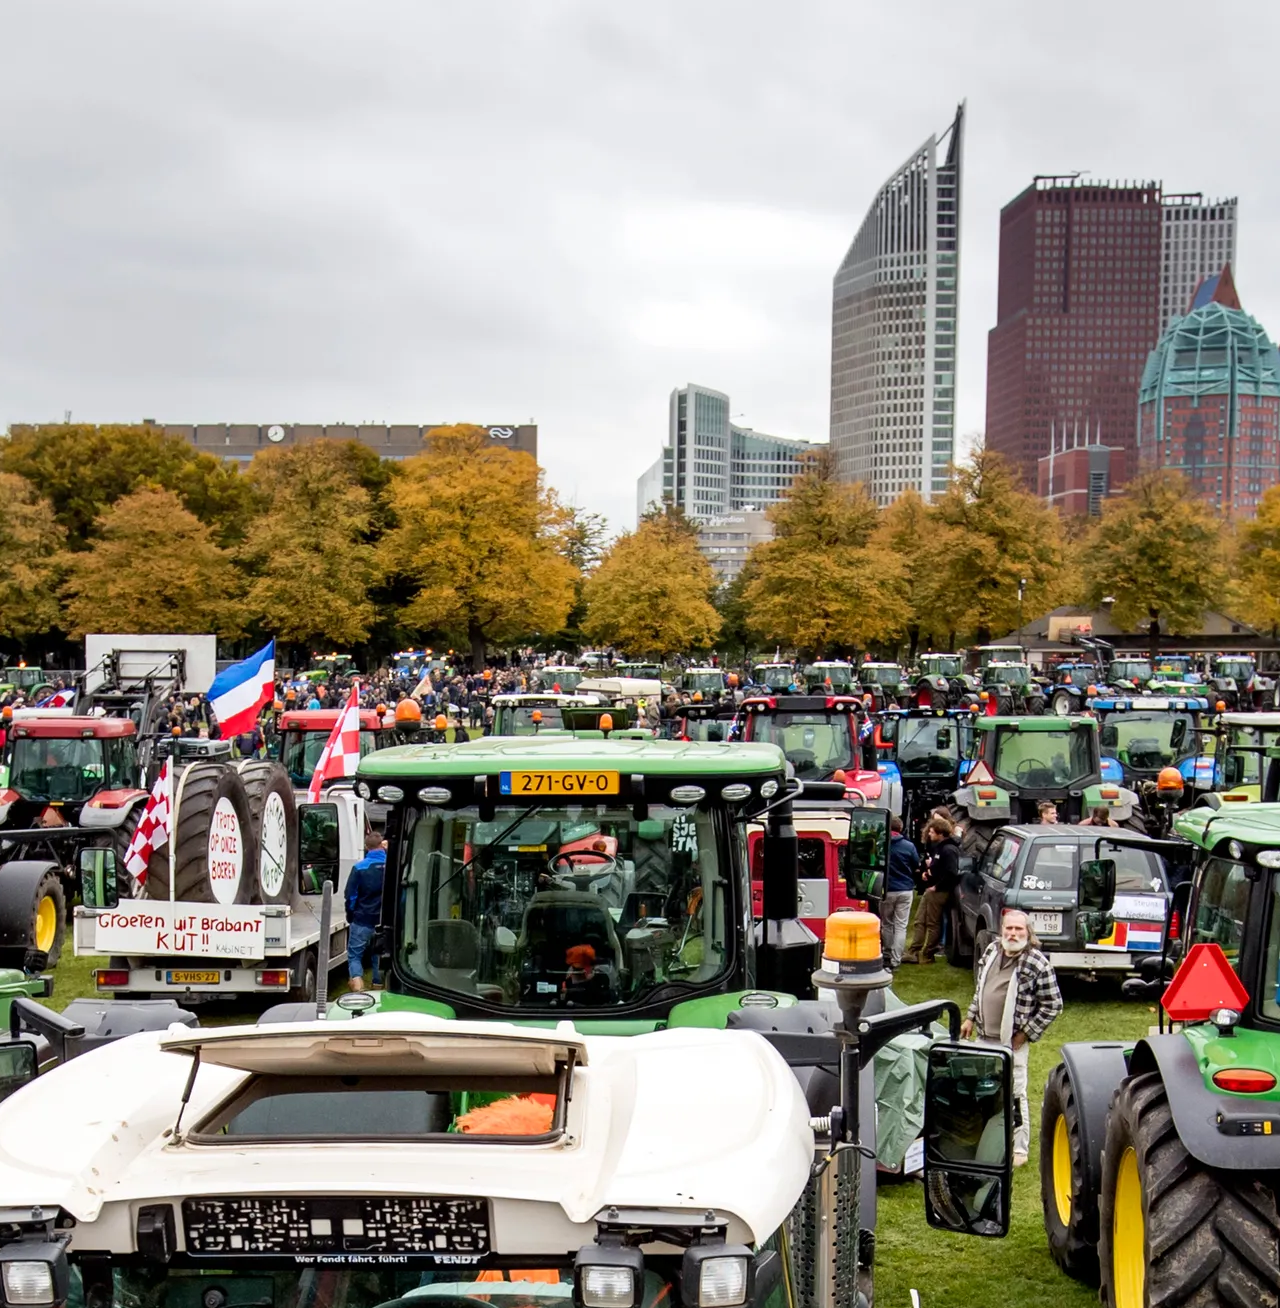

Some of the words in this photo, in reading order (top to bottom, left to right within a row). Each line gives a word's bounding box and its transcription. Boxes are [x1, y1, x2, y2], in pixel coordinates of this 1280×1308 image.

[215, 811, 236, 832] TROTS
[210, 833, 219, 851] OP
[221, 836, 237, 853] ONZE
[211, 860, 236, 880] BOEREN
[174, 972, 216, 982] 5-VHS-27
[294, 1255, 315, 1263] Wer
[317, 1255, 346, 1263] Fendt
[348, 1255, 376, 1264] fährt,
[378, 1254, 408, 1263] führt!
[433, 1255, 482, 1264] FENDT
